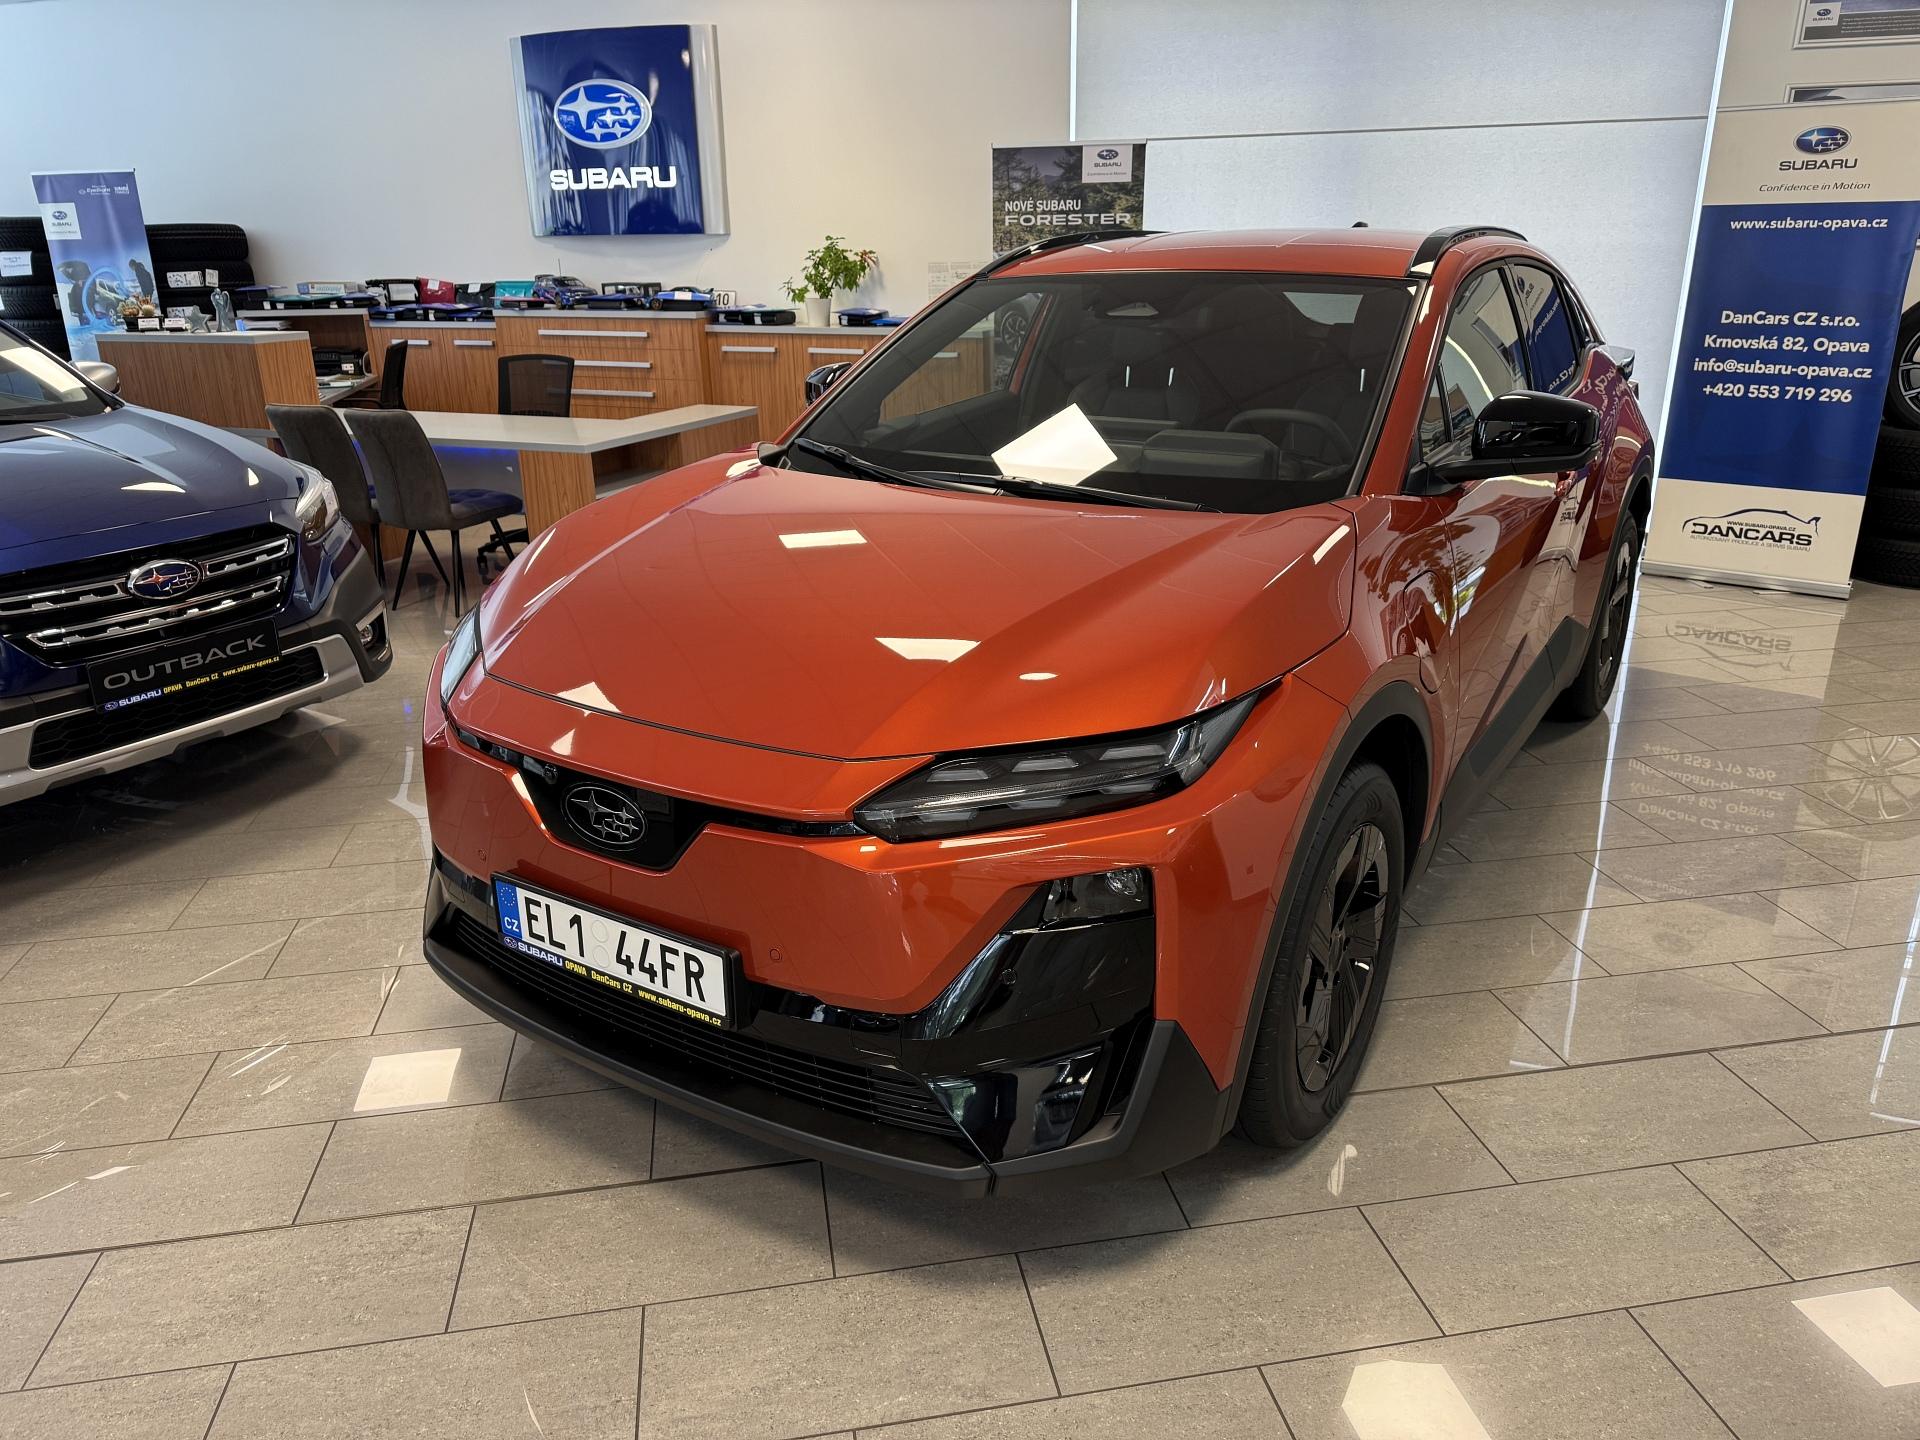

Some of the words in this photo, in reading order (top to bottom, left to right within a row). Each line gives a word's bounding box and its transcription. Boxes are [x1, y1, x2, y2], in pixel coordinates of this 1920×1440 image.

[1778, 158, 1858, 171] SUBARU
[550, 166, 677, 191] SUBARU
[1759, 183, 1819, 192] Confidence
[1820, 183, 1831, 191] in
[1832, 181, 1871, 191] Motion
[1004, 197, 1034, 212] NOVÉ
[1036, 199, 1082, 211] SUBARU
[1004, 213, 1132, 227] FORESTER
[1730, 217, 1889, 231] www.subaru-opava.cz
[1721, 310, 1789, 326] DanCars
[1793, 312, 1818, 326] CZ
[1820, 315, 1861, 327] s.r.o.
[1704, 334, 1778, 350] Krnovská
[1782, 337, 1808, 353] 82,
[1813, 338, 1870, 356] Opava
[1693, 358, 1873, 380] info@subaru-opava.cz
[1702, 383, 1744, 397] +420
[1748, 385, 1780, 399] 553
[1784, 386, 1815, 401] 719
[1818, 388, 1853, 403] 296
[1690, 522, 1813, 547] DANCARS
[103, 633, 267, 690] OUTBACK
[118, 688, 162, 707] SUBARU
[163, 683, 183, 694] OPAVA
[211, 672, 219, 682] CZ
[504, 916, 520, 933] CZ
[524, 896, 585, 958] EL1
[615, 930, 706, 1003] 44FR
[517, 941, 563, 968] SUBARU
[564, 959, 588, 977] OPAVA
[591, 970, 621, 990] DanCars
[622, 982, 633, 994] CZ
[638, 988, 722, 1027] www.subaru-opava.cz
